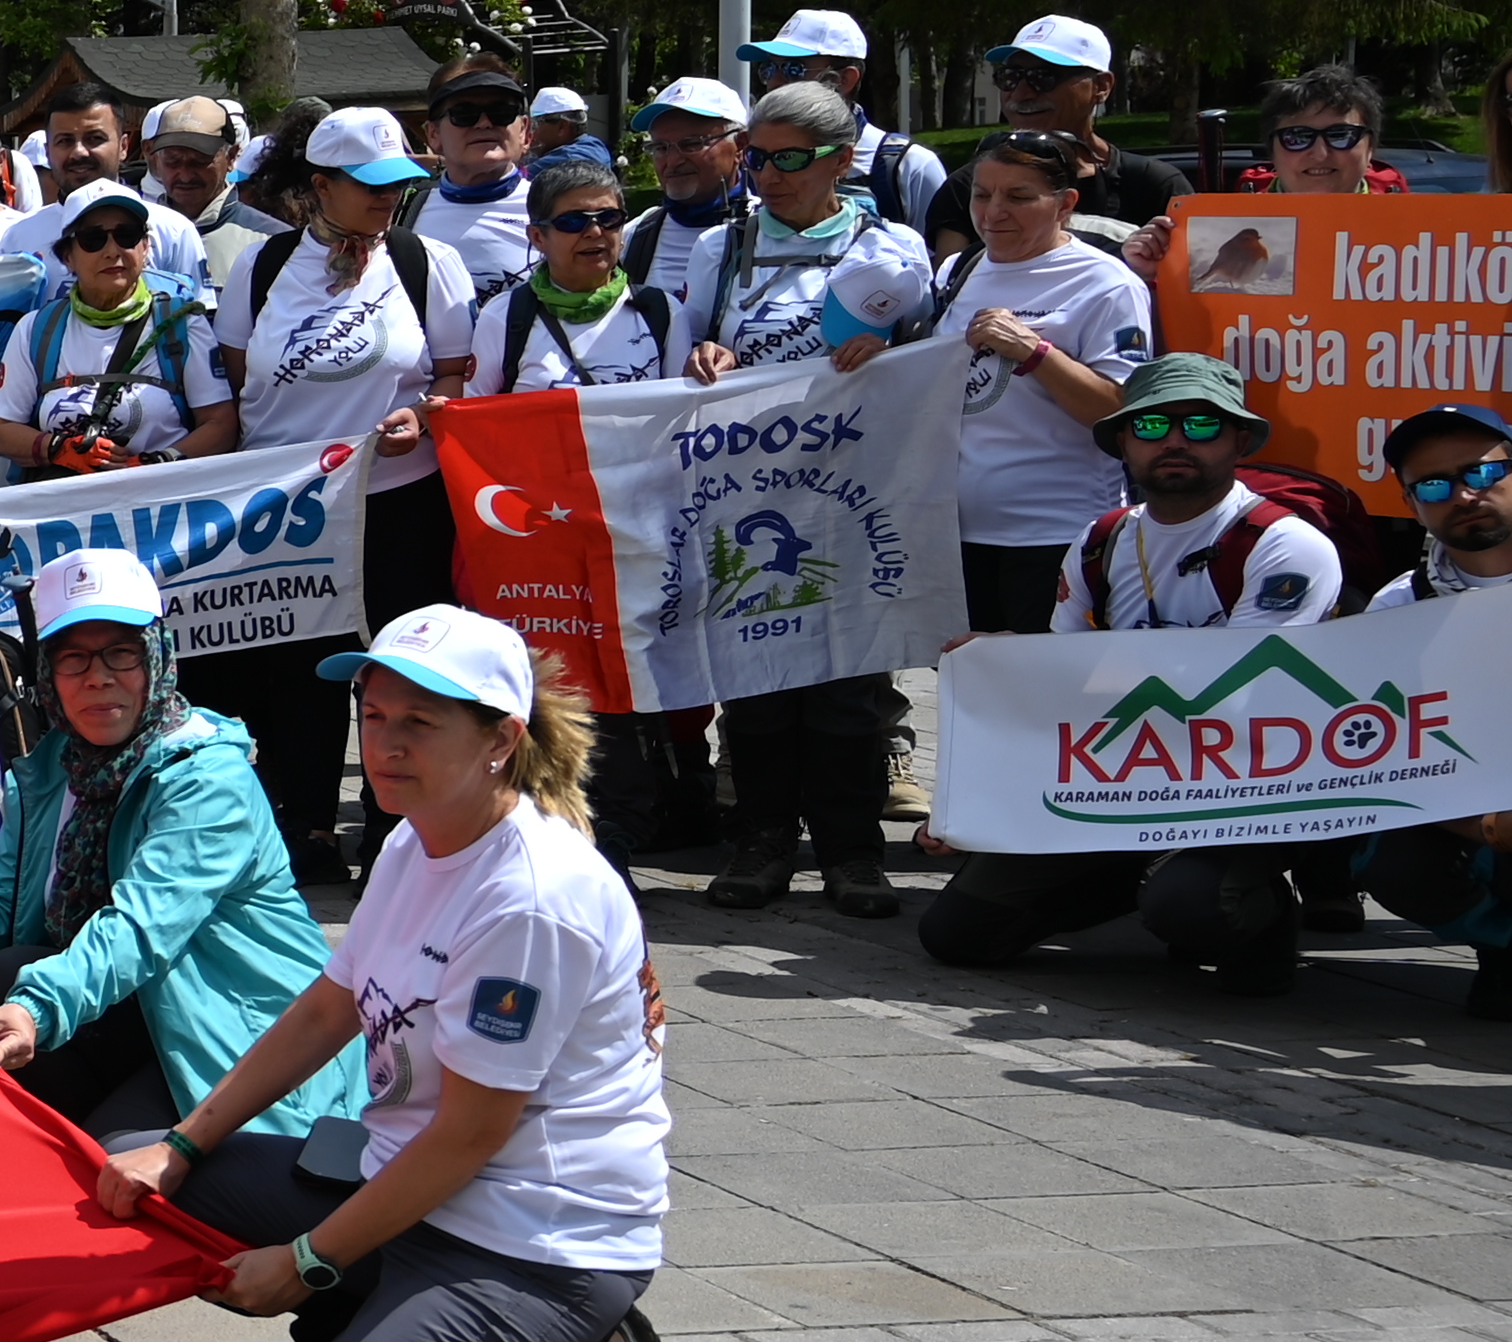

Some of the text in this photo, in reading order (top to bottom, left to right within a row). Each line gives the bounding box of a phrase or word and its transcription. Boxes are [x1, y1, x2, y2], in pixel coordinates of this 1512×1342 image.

[1332, 231, 1512, 304] kadıkö
[1223, 314, 1512, 393] doğa aktivi
[671, 406, 864, 471] TODOSK
[37, 476, 328, 584] PAKDOS
[660, 467, 910, 638] TOROSLAR DOĞA SPORLARI KULÜBÜ
[193, 575, 338, 615] KURTARMA
[496, 583, 593, 604] ANTALYA
[191, 607, 296, 652] KULÜBÜ
[738, 616, 803, 643] 1991
[1057, 690, 1450, 784] KARDOF
[1052, 758, 1458, 803] KARAMAN DOĞA FAALİYETLERİ ve GENÇLİK DERNEĞİ
[1138, 813, 1379, 843] DOĞAYI BİZİMLE YAŞAYIN
